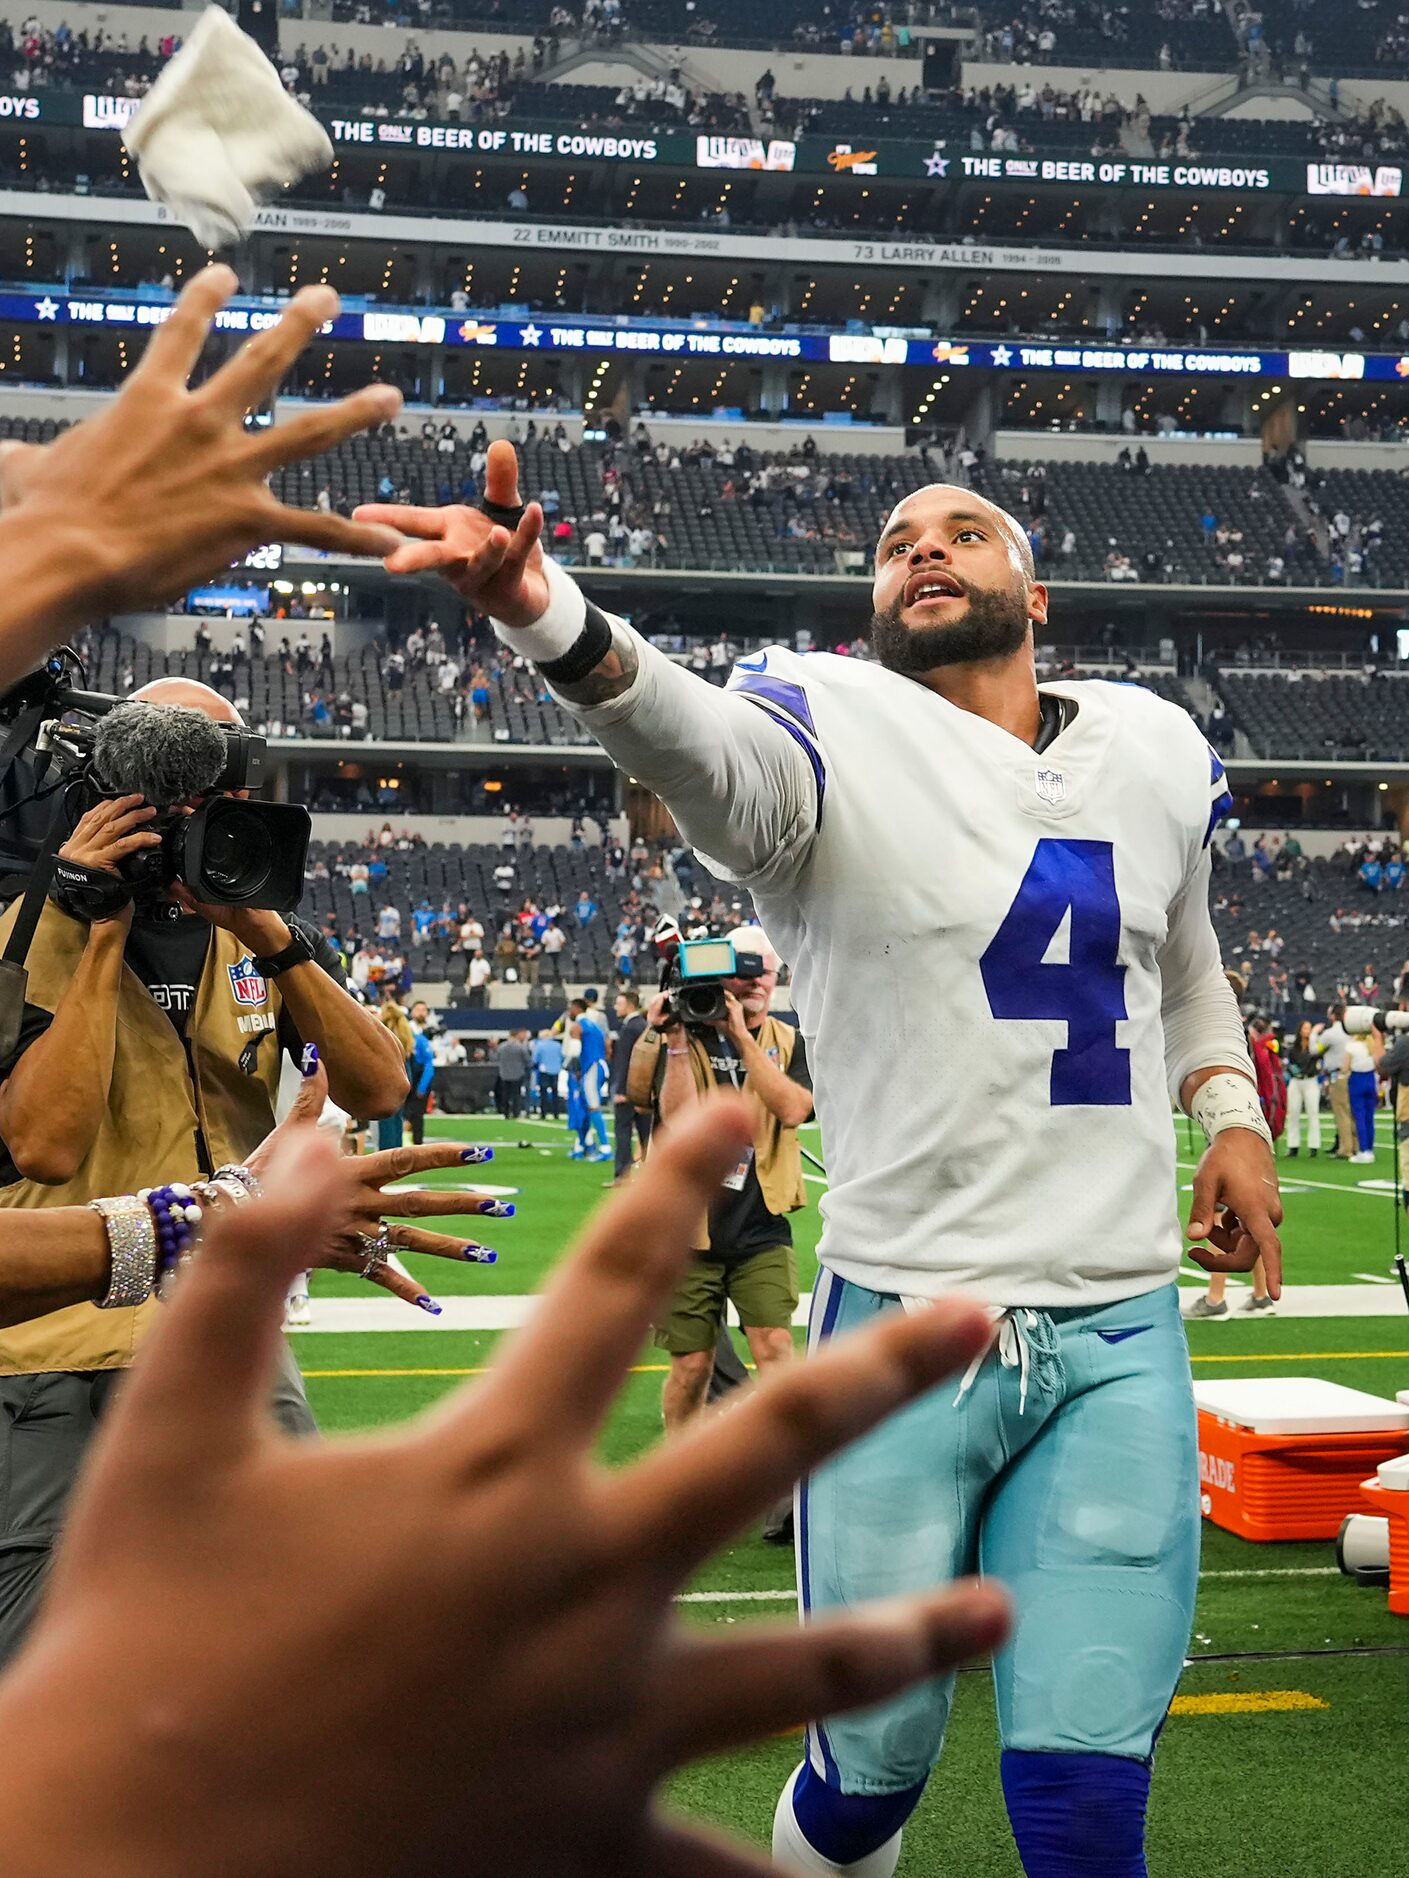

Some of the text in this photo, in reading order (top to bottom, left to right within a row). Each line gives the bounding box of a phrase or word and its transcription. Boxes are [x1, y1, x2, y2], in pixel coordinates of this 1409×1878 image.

[332, 120, 374, 142] THE
[417, 127, 473, 149] BEER
[478, 130, 506, 150] OF
[510, 133, 553, 153] THE
[557, 135, 657, 159] COWBOYS
[961, 156, 1002, 177] THE
[1042, 161, 1095, 181] BEER
[1099, 164, 1126, 182] OF
[1130, 165, 1170, 184] THE
[1174, 167, 1269, 188] COWBOYS
[513, 228, 531, 242] 22
[537, 229, 602, 246] EMMITT
[607, 233, 659, 249] SMITH
[853, 245, 873, 260] 73
[880, 248, 935, 262] LARRY
[939, 250, 994, 264] ALLEN
[68, 301, 104, 321] THE
[215, 311, 248, 330] THE
[550, 328, 585, 346] THE
[615, 331, 661, 350] BEER
[662, 333, 686, 350] OF
[687, 335, 721, 353] THE
[722, 336, 801, 356] COWBOYS
[1020, 349, 1054, 366] THE
[1082, 351, 1126, 368] BEER
[1127, 353, 1150, 369] OF
[1150, 353, 1184, 370] THE
[1185, 355, 1261, 373] COWBOYS
[1040, 781, 1062, 796] NFL
[57, 867, 89, 882] FUJINON
[979, 838, 1132, 1105] 4
[236, 978, 265, 1001] NFL
